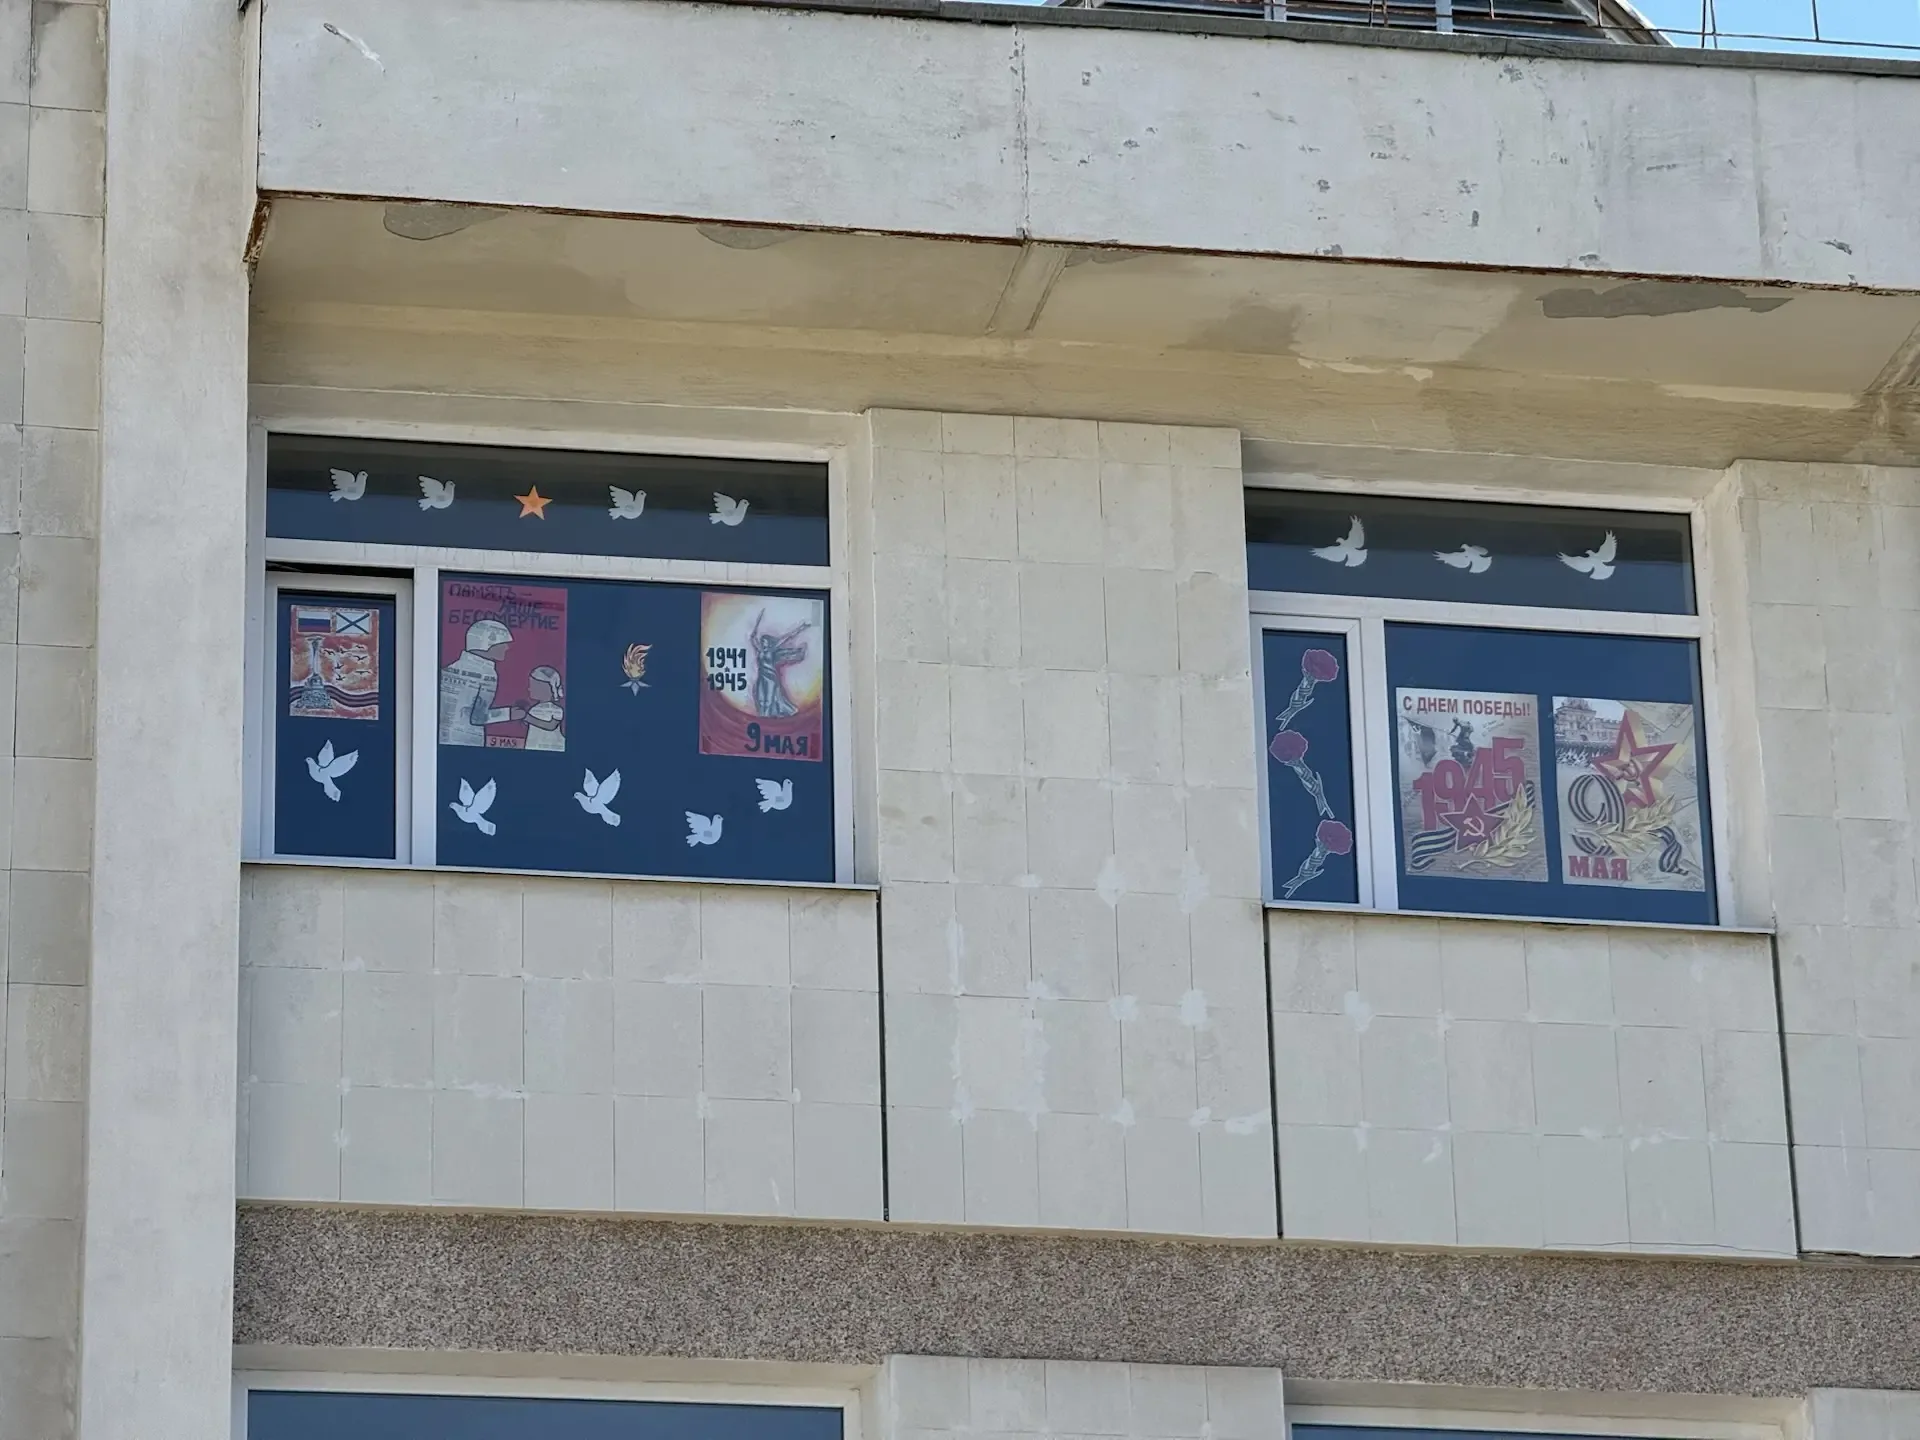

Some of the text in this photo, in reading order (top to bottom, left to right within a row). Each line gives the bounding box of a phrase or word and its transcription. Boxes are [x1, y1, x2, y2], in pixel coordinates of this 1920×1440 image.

[706, 647, 747, 668] 1941
[707, 672, 748, 691] 1945
[1403, 696, 1531, 718] С ДНЕМ ПОБЕДЫ!
[490, 737, 517, 747] 9 МАЯ
[744, 722, 809, 756] 9 МАЯ
[1413, 736, 1526, 831] 1945
[1568, 855, 1630, 881] МАЯ
